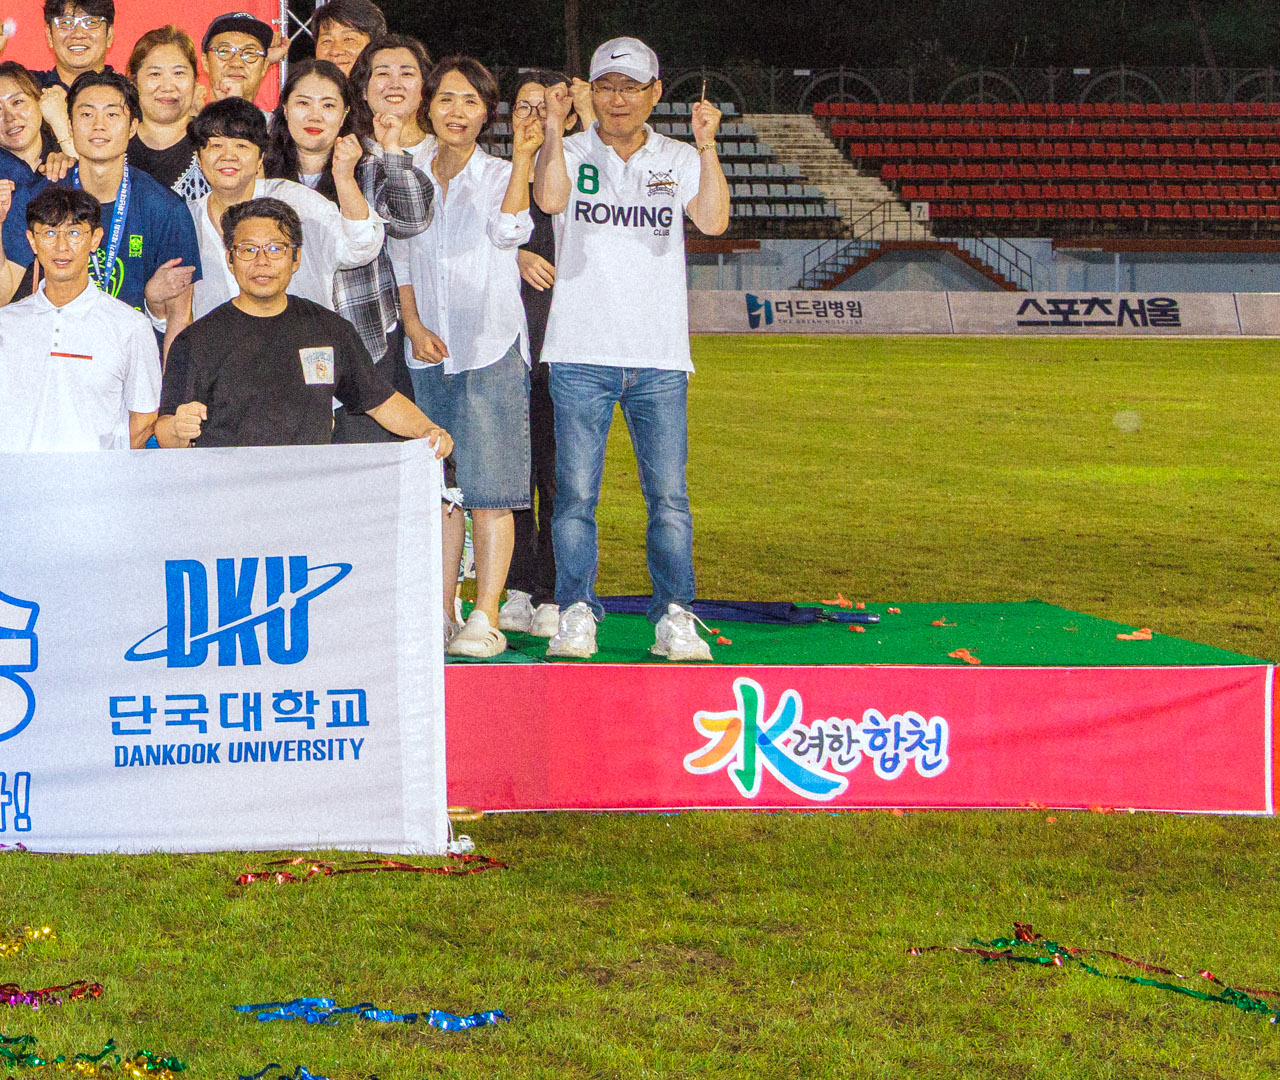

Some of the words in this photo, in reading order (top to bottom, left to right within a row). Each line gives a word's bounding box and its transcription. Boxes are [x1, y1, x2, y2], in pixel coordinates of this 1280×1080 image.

[577, 163, 600, 195] 8
[575, 200, 673, 228] ROWING
[917, 205, 924, 218] 7
[653, 228, 670, 236] CLUB
[775, 300, 863, 318] 더드림병원
[1016, 297, 1182, 327] 스포츠서울
[165, 555, 309, 668] DKU
[109, 688, 370, 736] 단국대학교
[114, 742, 221, 768] DANKOOK
[229, 738, 365, 764] UNIVERSITY
[862, 710, 947, 779] 합천
